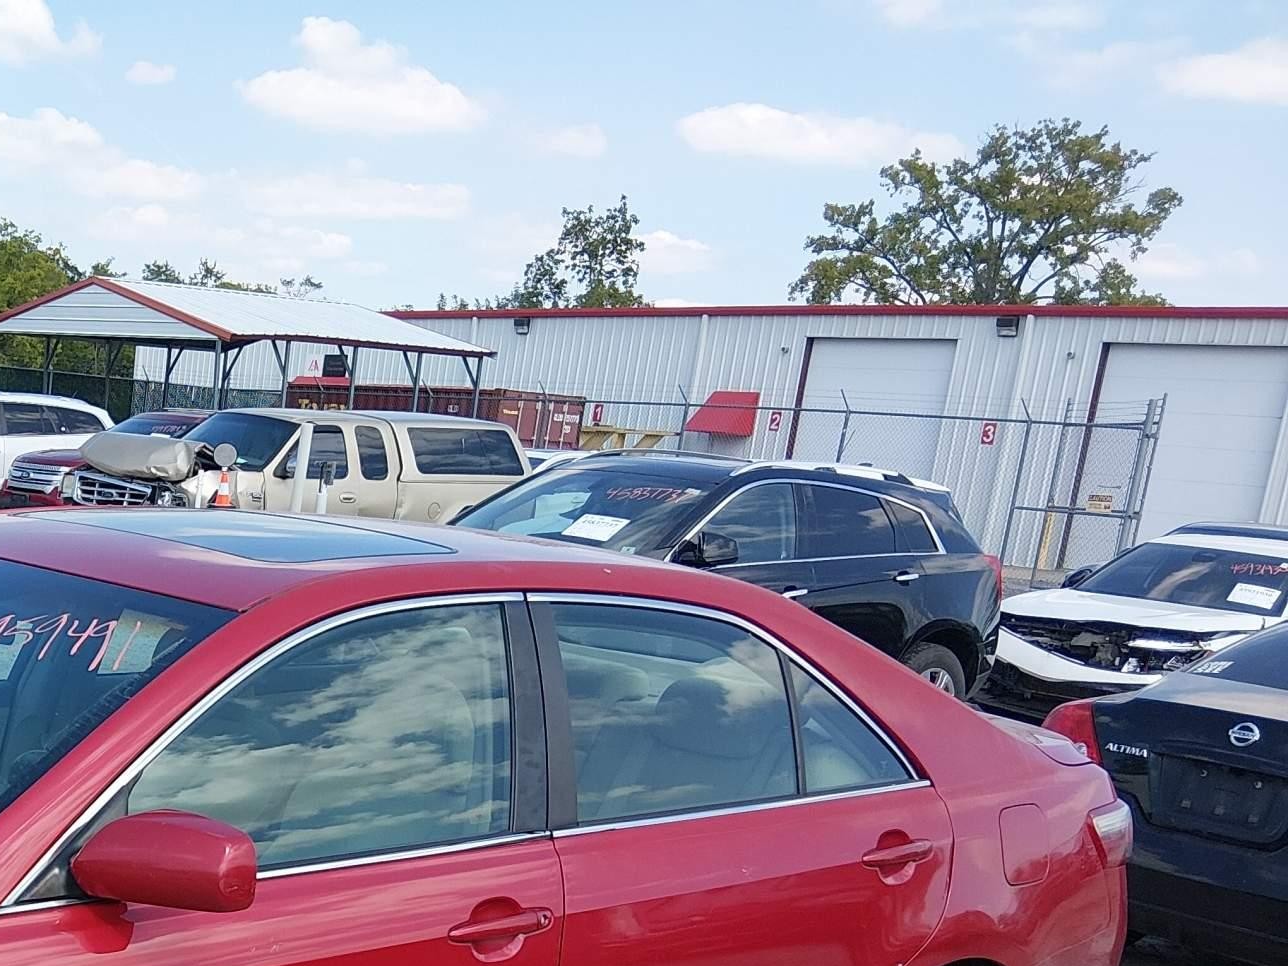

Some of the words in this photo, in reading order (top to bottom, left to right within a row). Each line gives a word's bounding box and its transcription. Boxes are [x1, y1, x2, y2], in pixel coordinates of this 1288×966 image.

[596, 407, 602, 420] 1
[769, 413, 780, 430] 2
[982, 424, 996, 443] 3
[1105, 742, 1148, 758] ALTIMA
